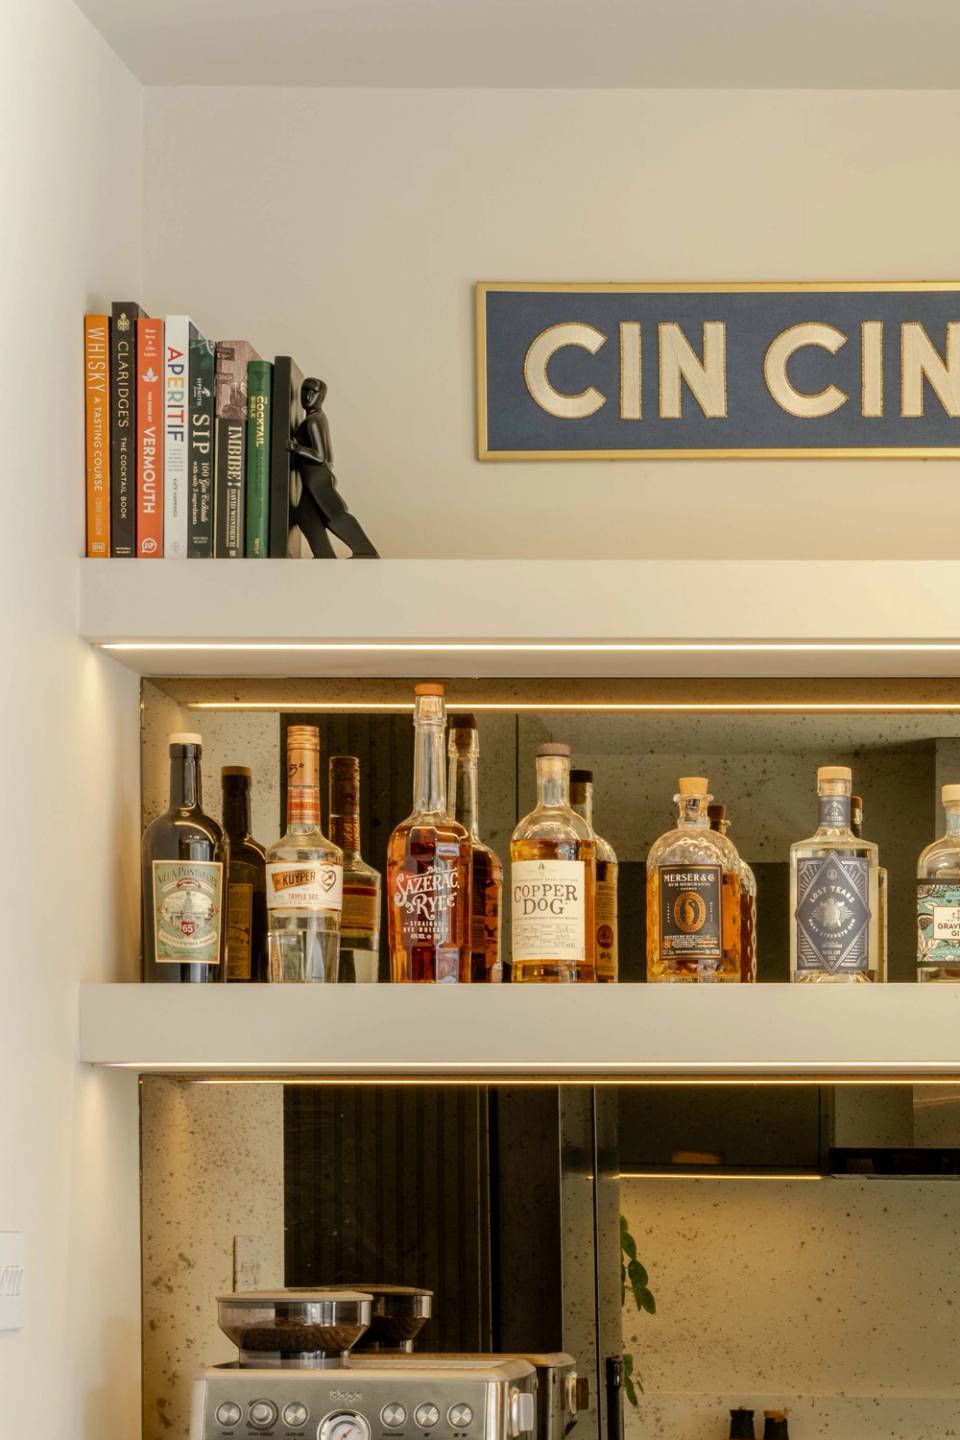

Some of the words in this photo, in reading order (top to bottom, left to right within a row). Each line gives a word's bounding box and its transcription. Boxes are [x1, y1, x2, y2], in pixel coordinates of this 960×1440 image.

[88, 327, 105, 392] WHISKY
[524, 321, 728, 420] CIN
[94, 396, 102, 404] A
[117, 341, 129, 428] CLARIDGE'S
[167, 346, 184, 442] APERITIF
[94, 407, 102, 448] TASTING
[192, 414, 210, 454] SIP
[256, 395, 264, 448] COCKTAIL
[94, 450, 102, 492] COURSE
[143, 426, 156, 513] VERMOUTH
[282, 871, 316, 887] KUYPER
[513, 884, 578, 903] COPPER
[809, 885, 827, 903] LOST
[830, 885, 855, 904] YEARS
[523, 898, 564, 915] DOG
